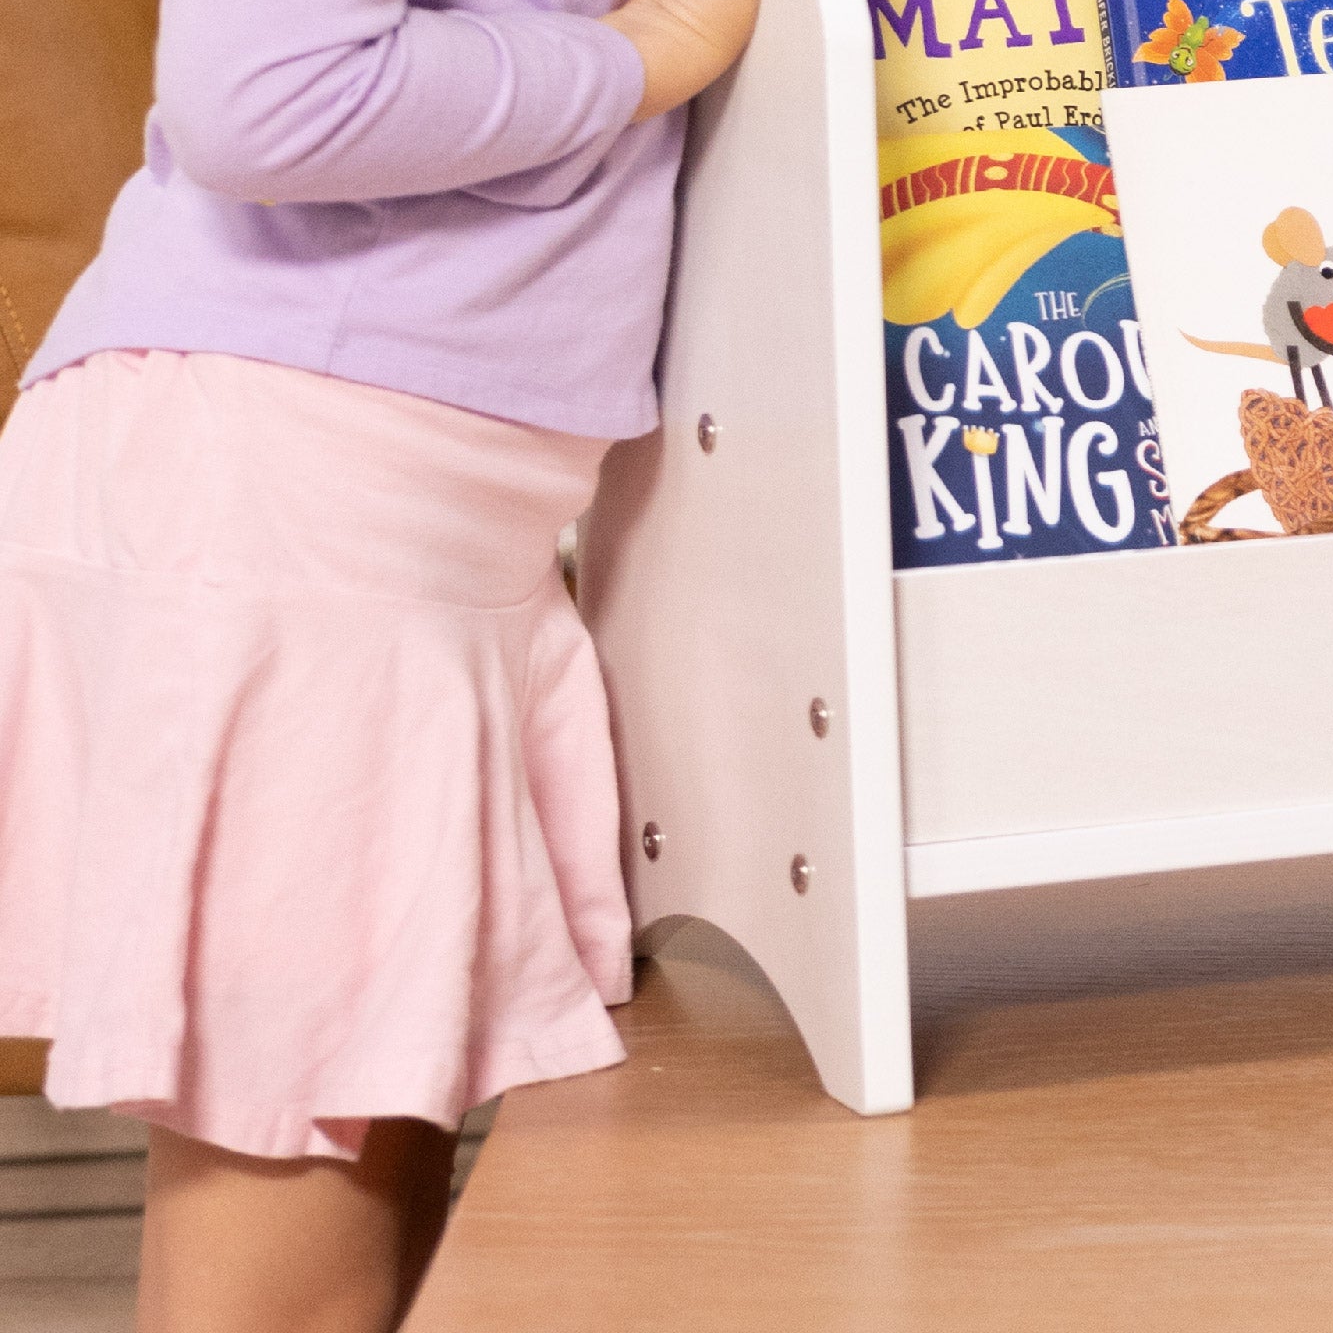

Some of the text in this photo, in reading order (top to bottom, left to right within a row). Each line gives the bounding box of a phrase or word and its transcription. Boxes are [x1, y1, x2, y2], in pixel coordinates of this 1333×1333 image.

[896, 91, 952, 125] The
[995, 106, 1053, 130] Paul
[1034, 290, 1082, 321] THE
[897, 413, 1135, 550] KING
